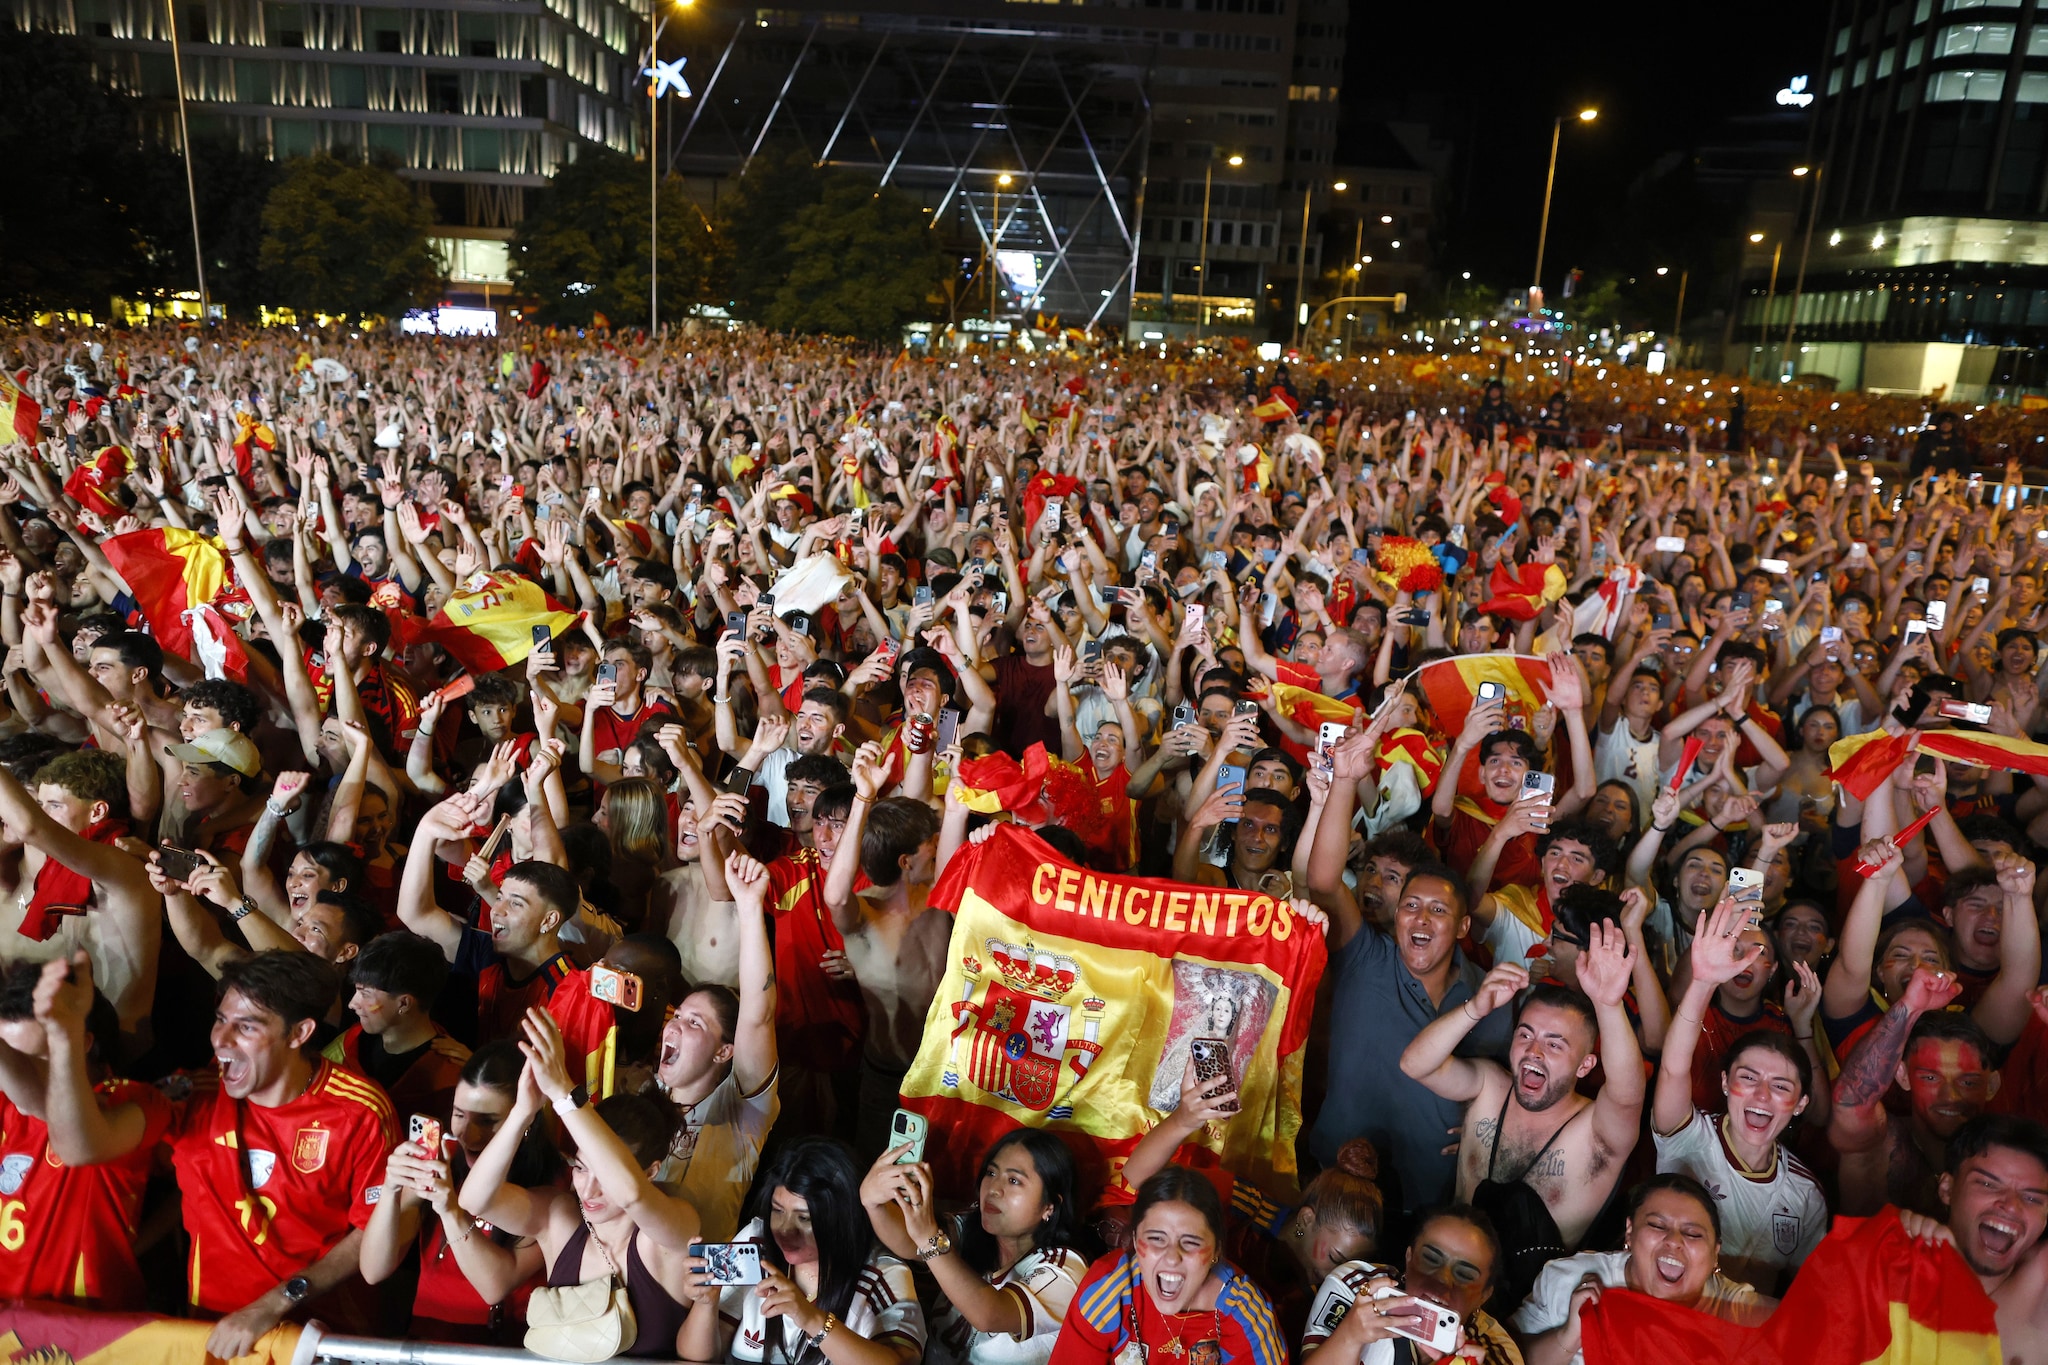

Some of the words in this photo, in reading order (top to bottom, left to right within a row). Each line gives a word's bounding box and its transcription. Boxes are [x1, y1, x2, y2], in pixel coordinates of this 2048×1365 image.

[1031, 862, 1297, 942] CENICIENTOS
[1202, 1120, 1222, 1140] ble
[0, 1199, 26, 1252] 6
